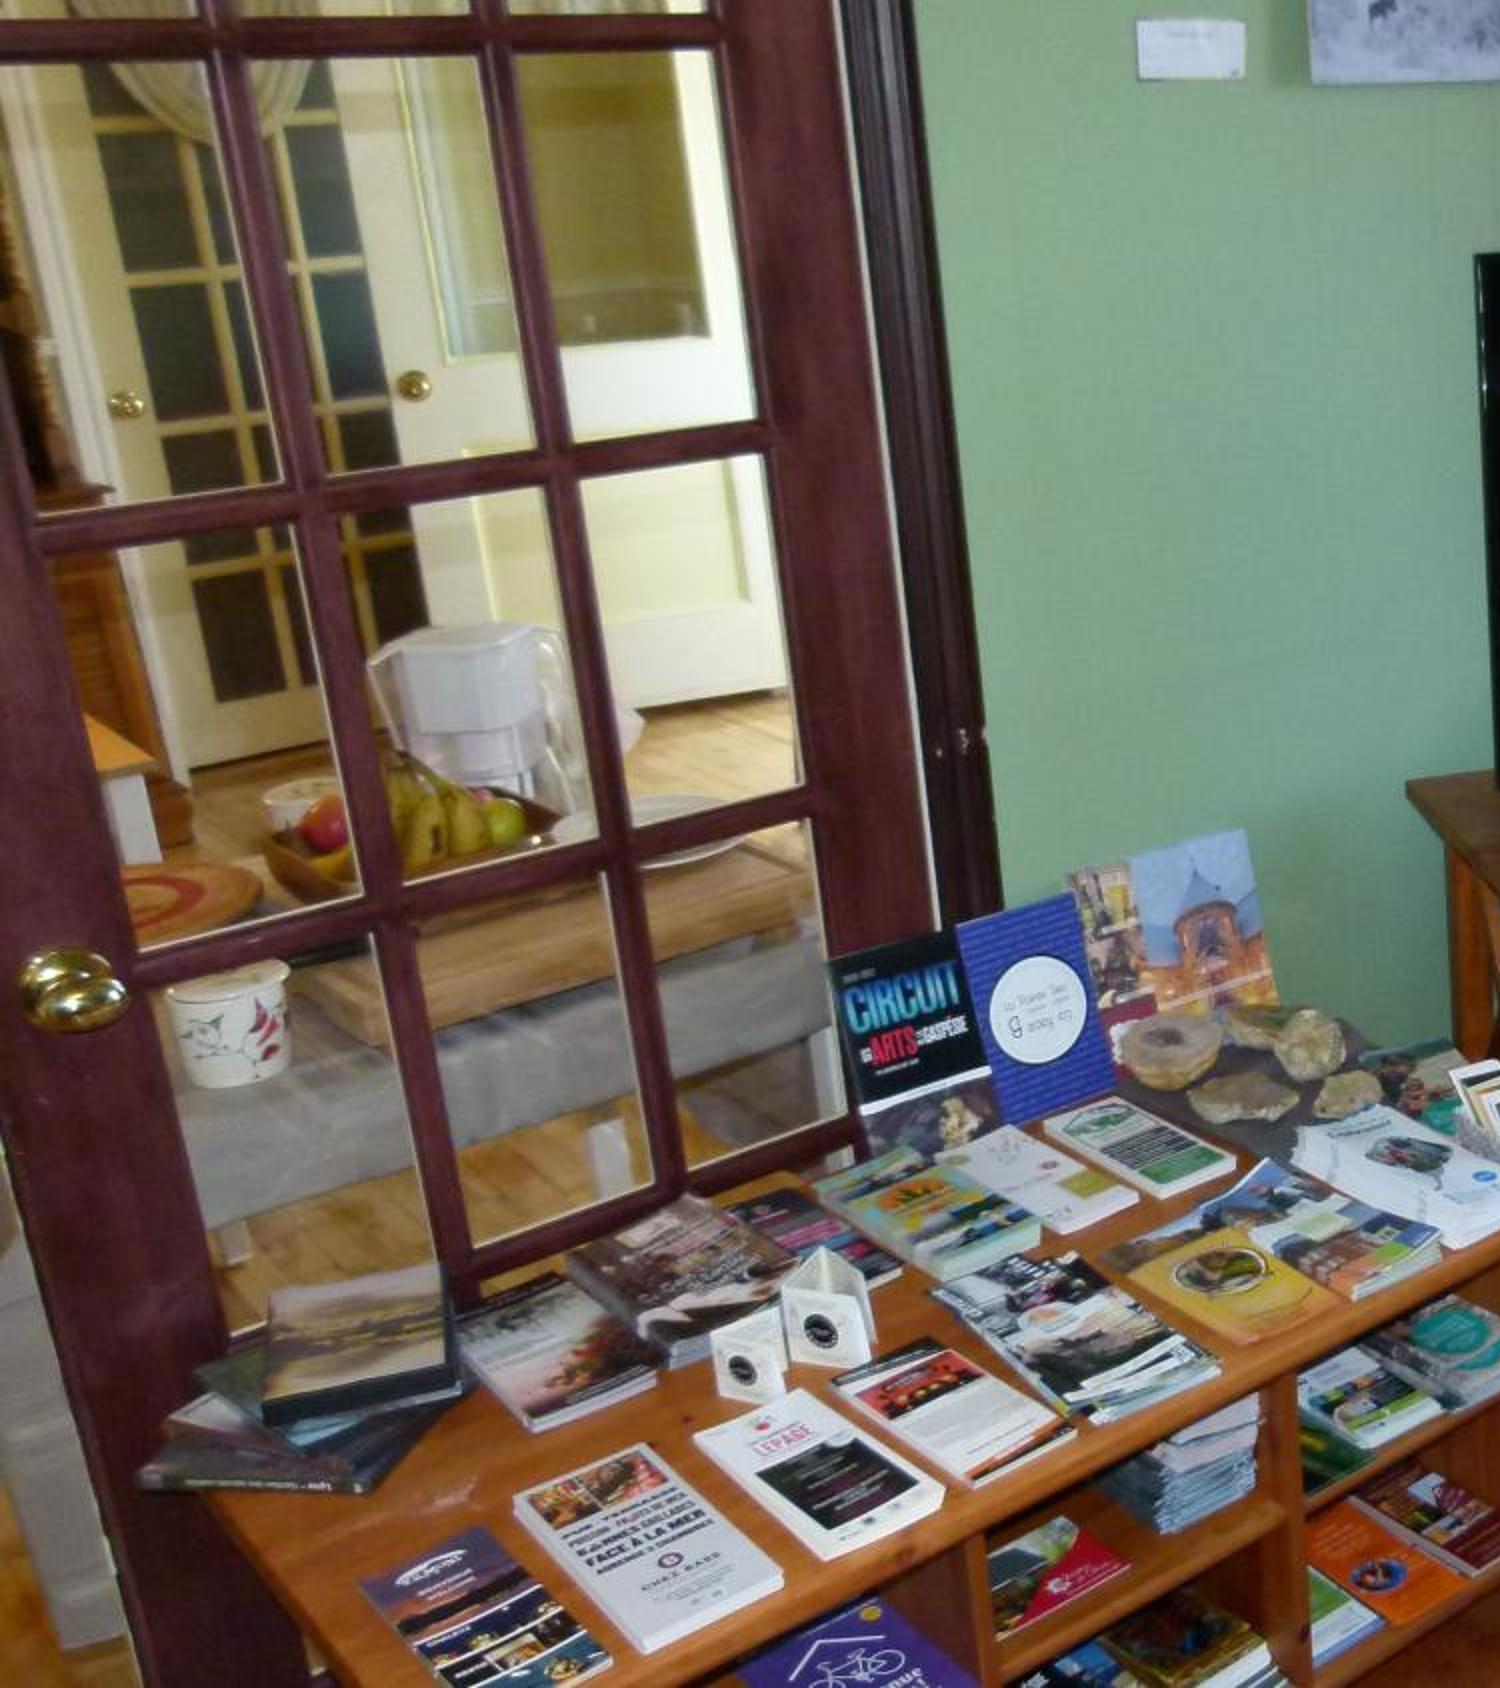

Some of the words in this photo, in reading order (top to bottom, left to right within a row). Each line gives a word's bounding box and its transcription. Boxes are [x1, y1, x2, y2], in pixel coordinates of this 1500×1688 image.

[844, 961, 960, 1034] CIRCUIT
[869, 1025, 919, 1067] ARTS
[585, 1543, 629, 1567] FACE
[631, 1535, 643, 1548] À
[644, 1526, 667, 1541] LA
[667, 1508, 706, 1530] MER
